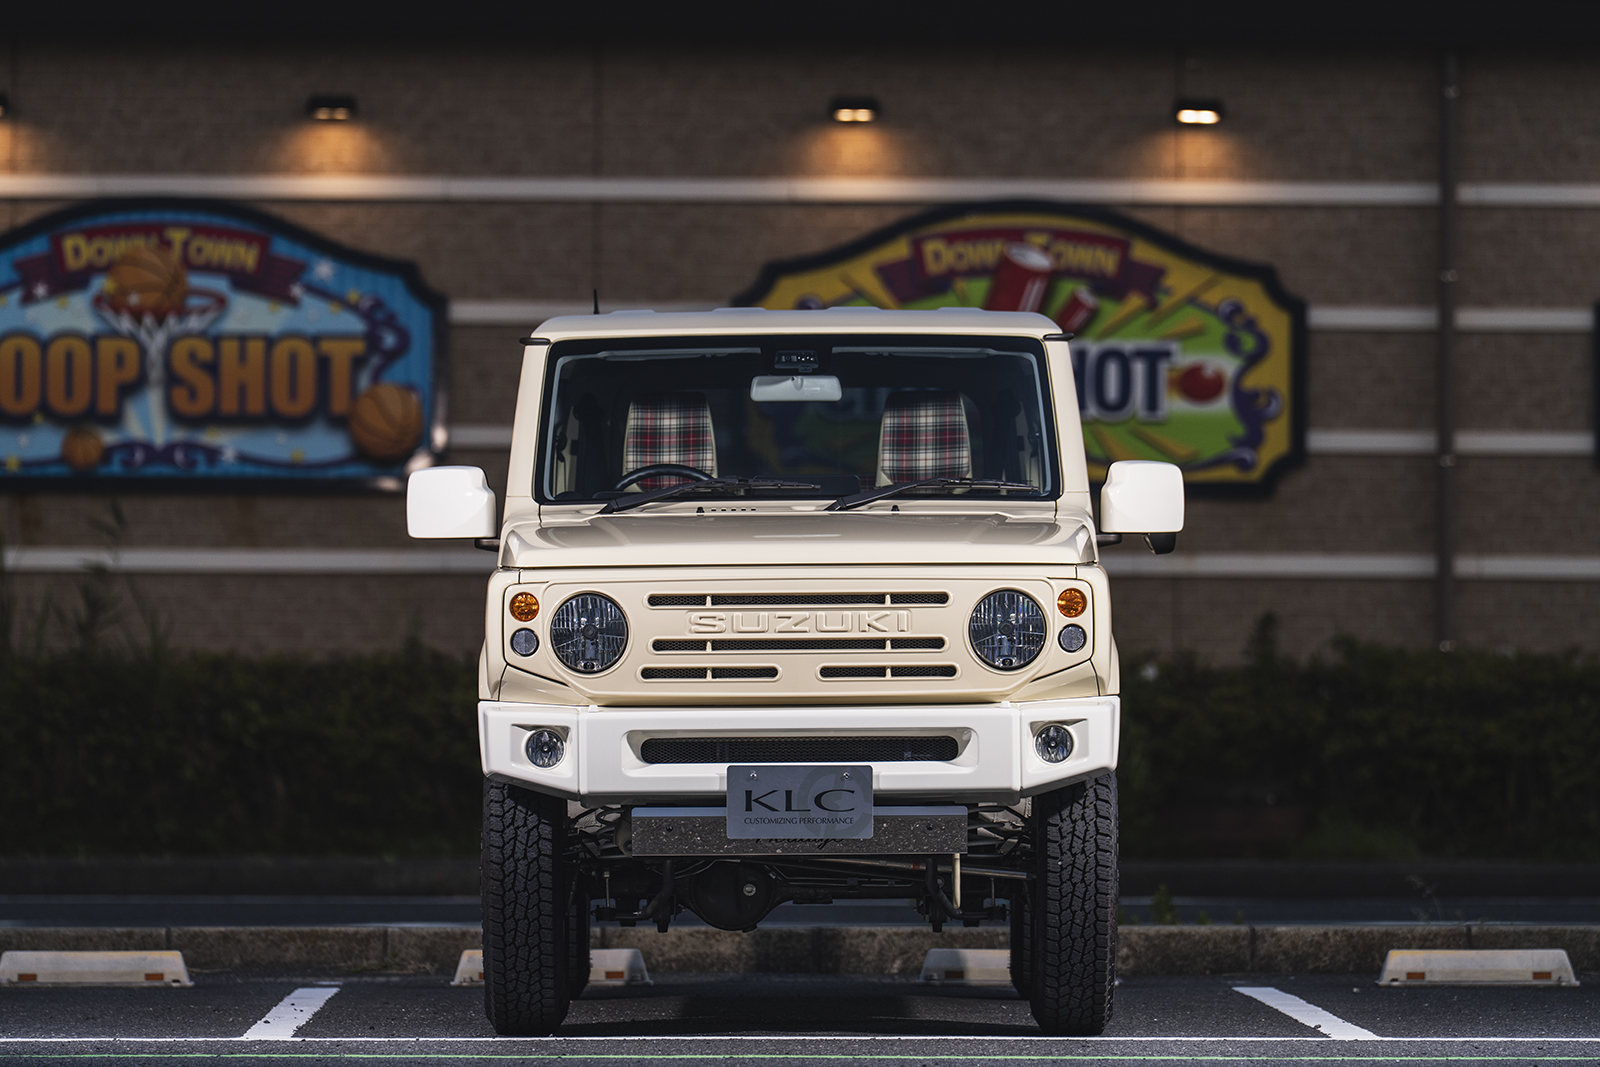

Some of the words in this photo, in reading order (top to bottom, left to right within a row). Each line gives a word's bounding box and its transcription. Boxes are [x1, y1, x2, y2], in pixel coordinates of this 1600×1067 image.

[922, 238, 1004, 276] DOW
[171, 337, 366, 416] SHOT
[689, 609, 911, 634] SUZUKI
[744, 789, 856, 813] KLC
[743, 816, 798, 826] CUSTOMIZING
[799, 816, 854, 826] PERFORMANCE
